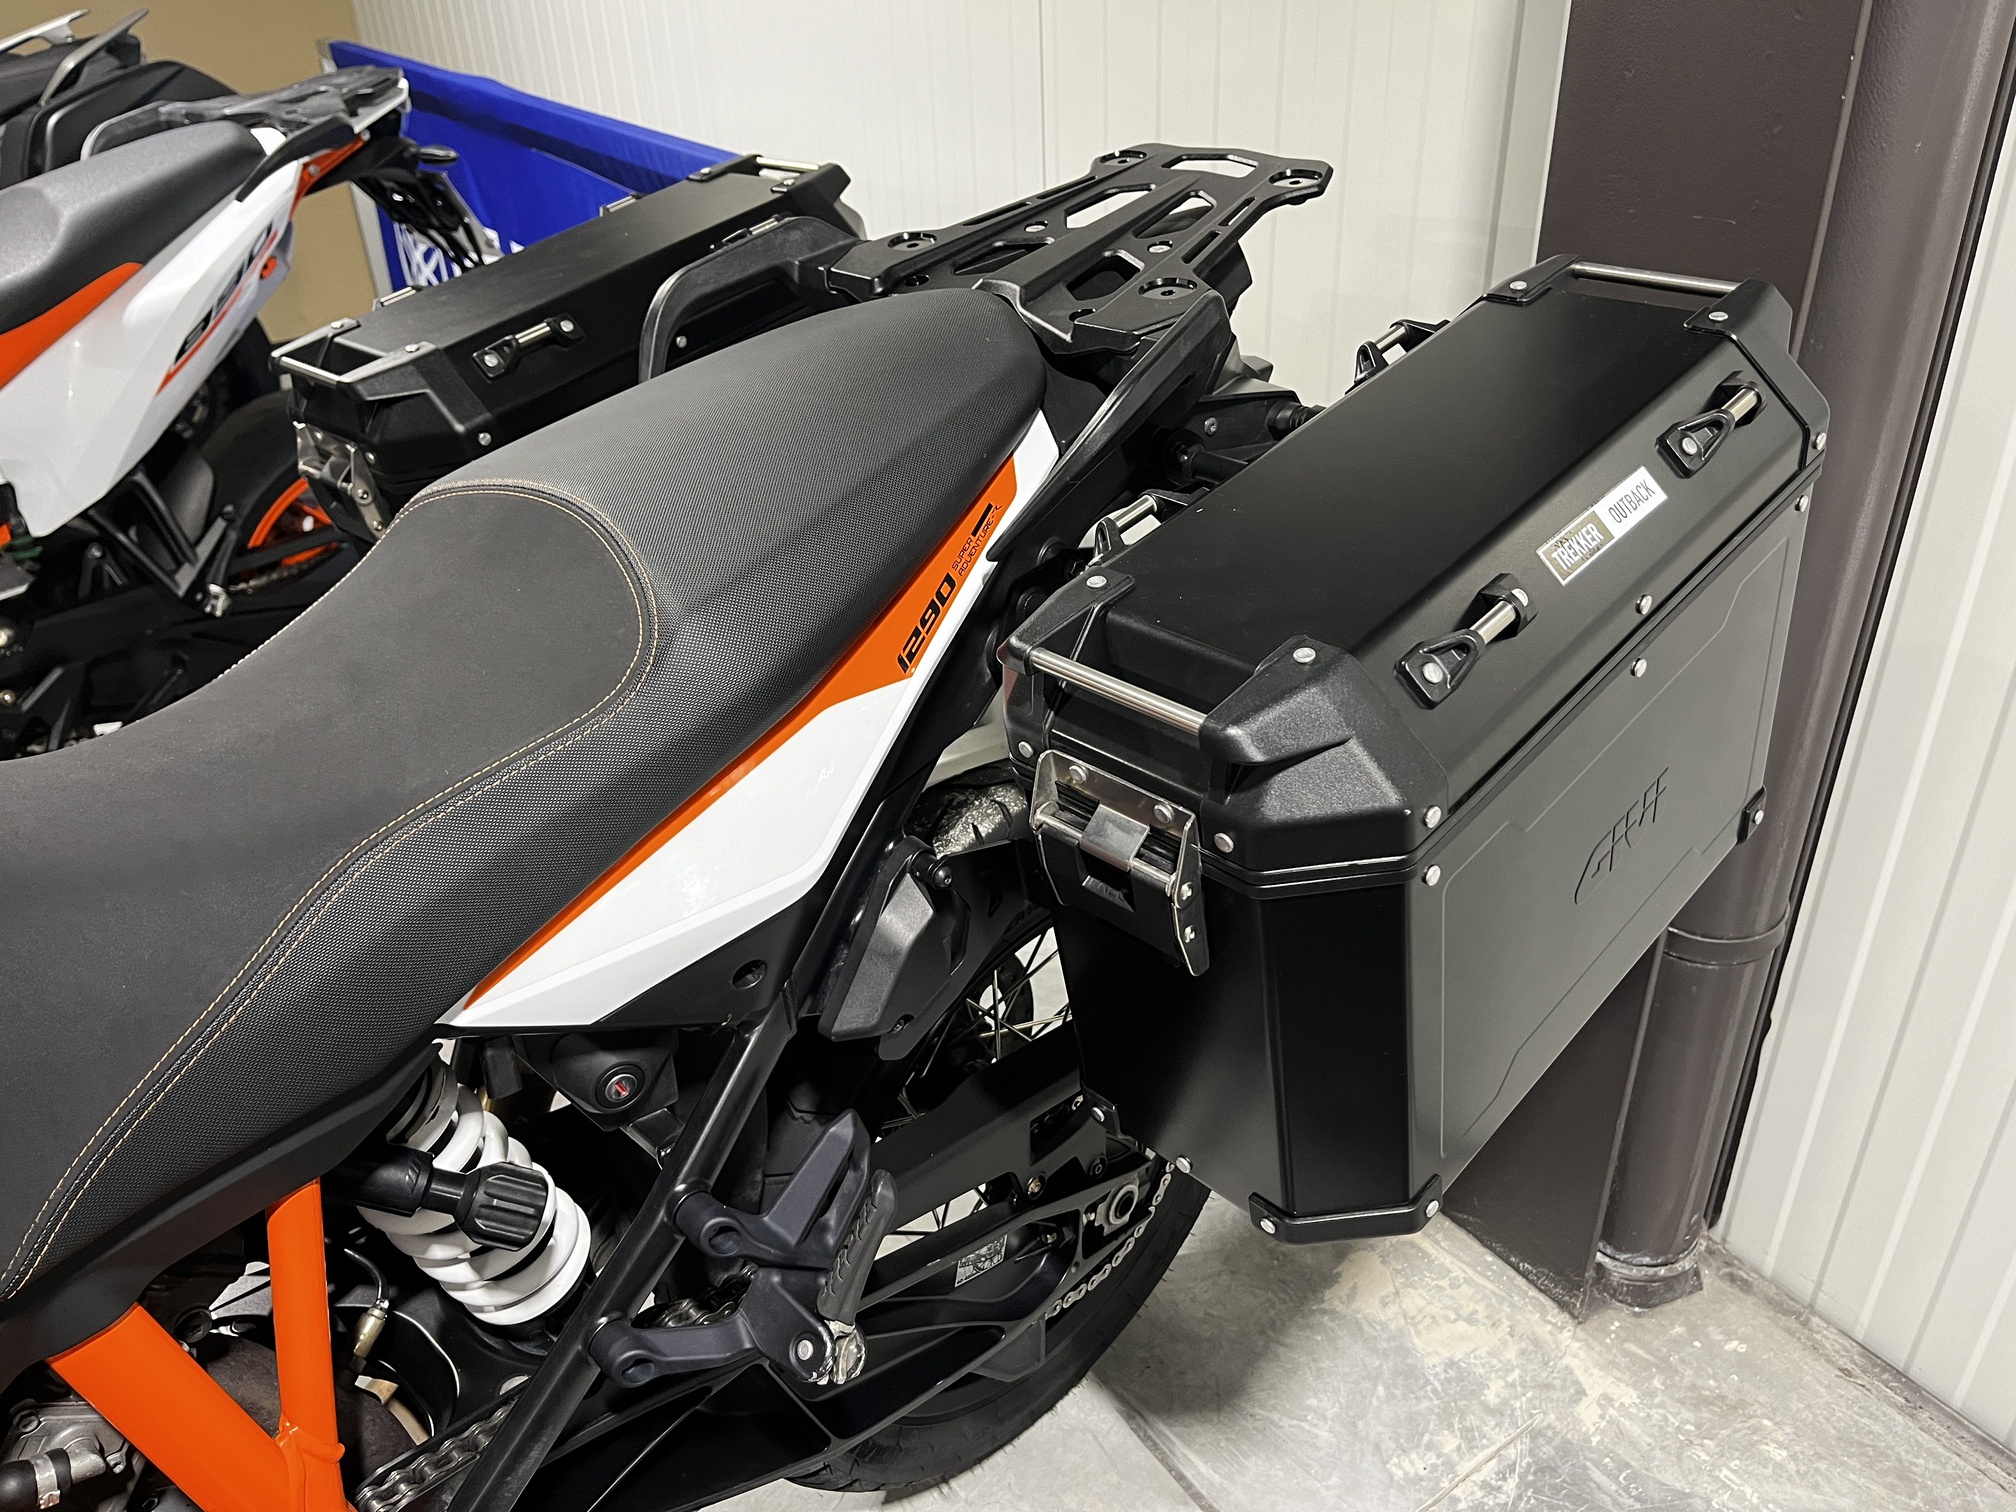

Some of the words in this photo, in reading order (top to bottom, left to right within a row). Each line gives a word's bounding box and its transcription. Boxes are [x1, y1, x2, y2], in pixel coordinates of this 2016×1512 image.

[951, 536, 973, 571] SUPER
[1551, 523, 1604, 570] TREKKER
[1608, 479, 1656, 524] OUTBACK
[897, 572, 957, 674] 1290
